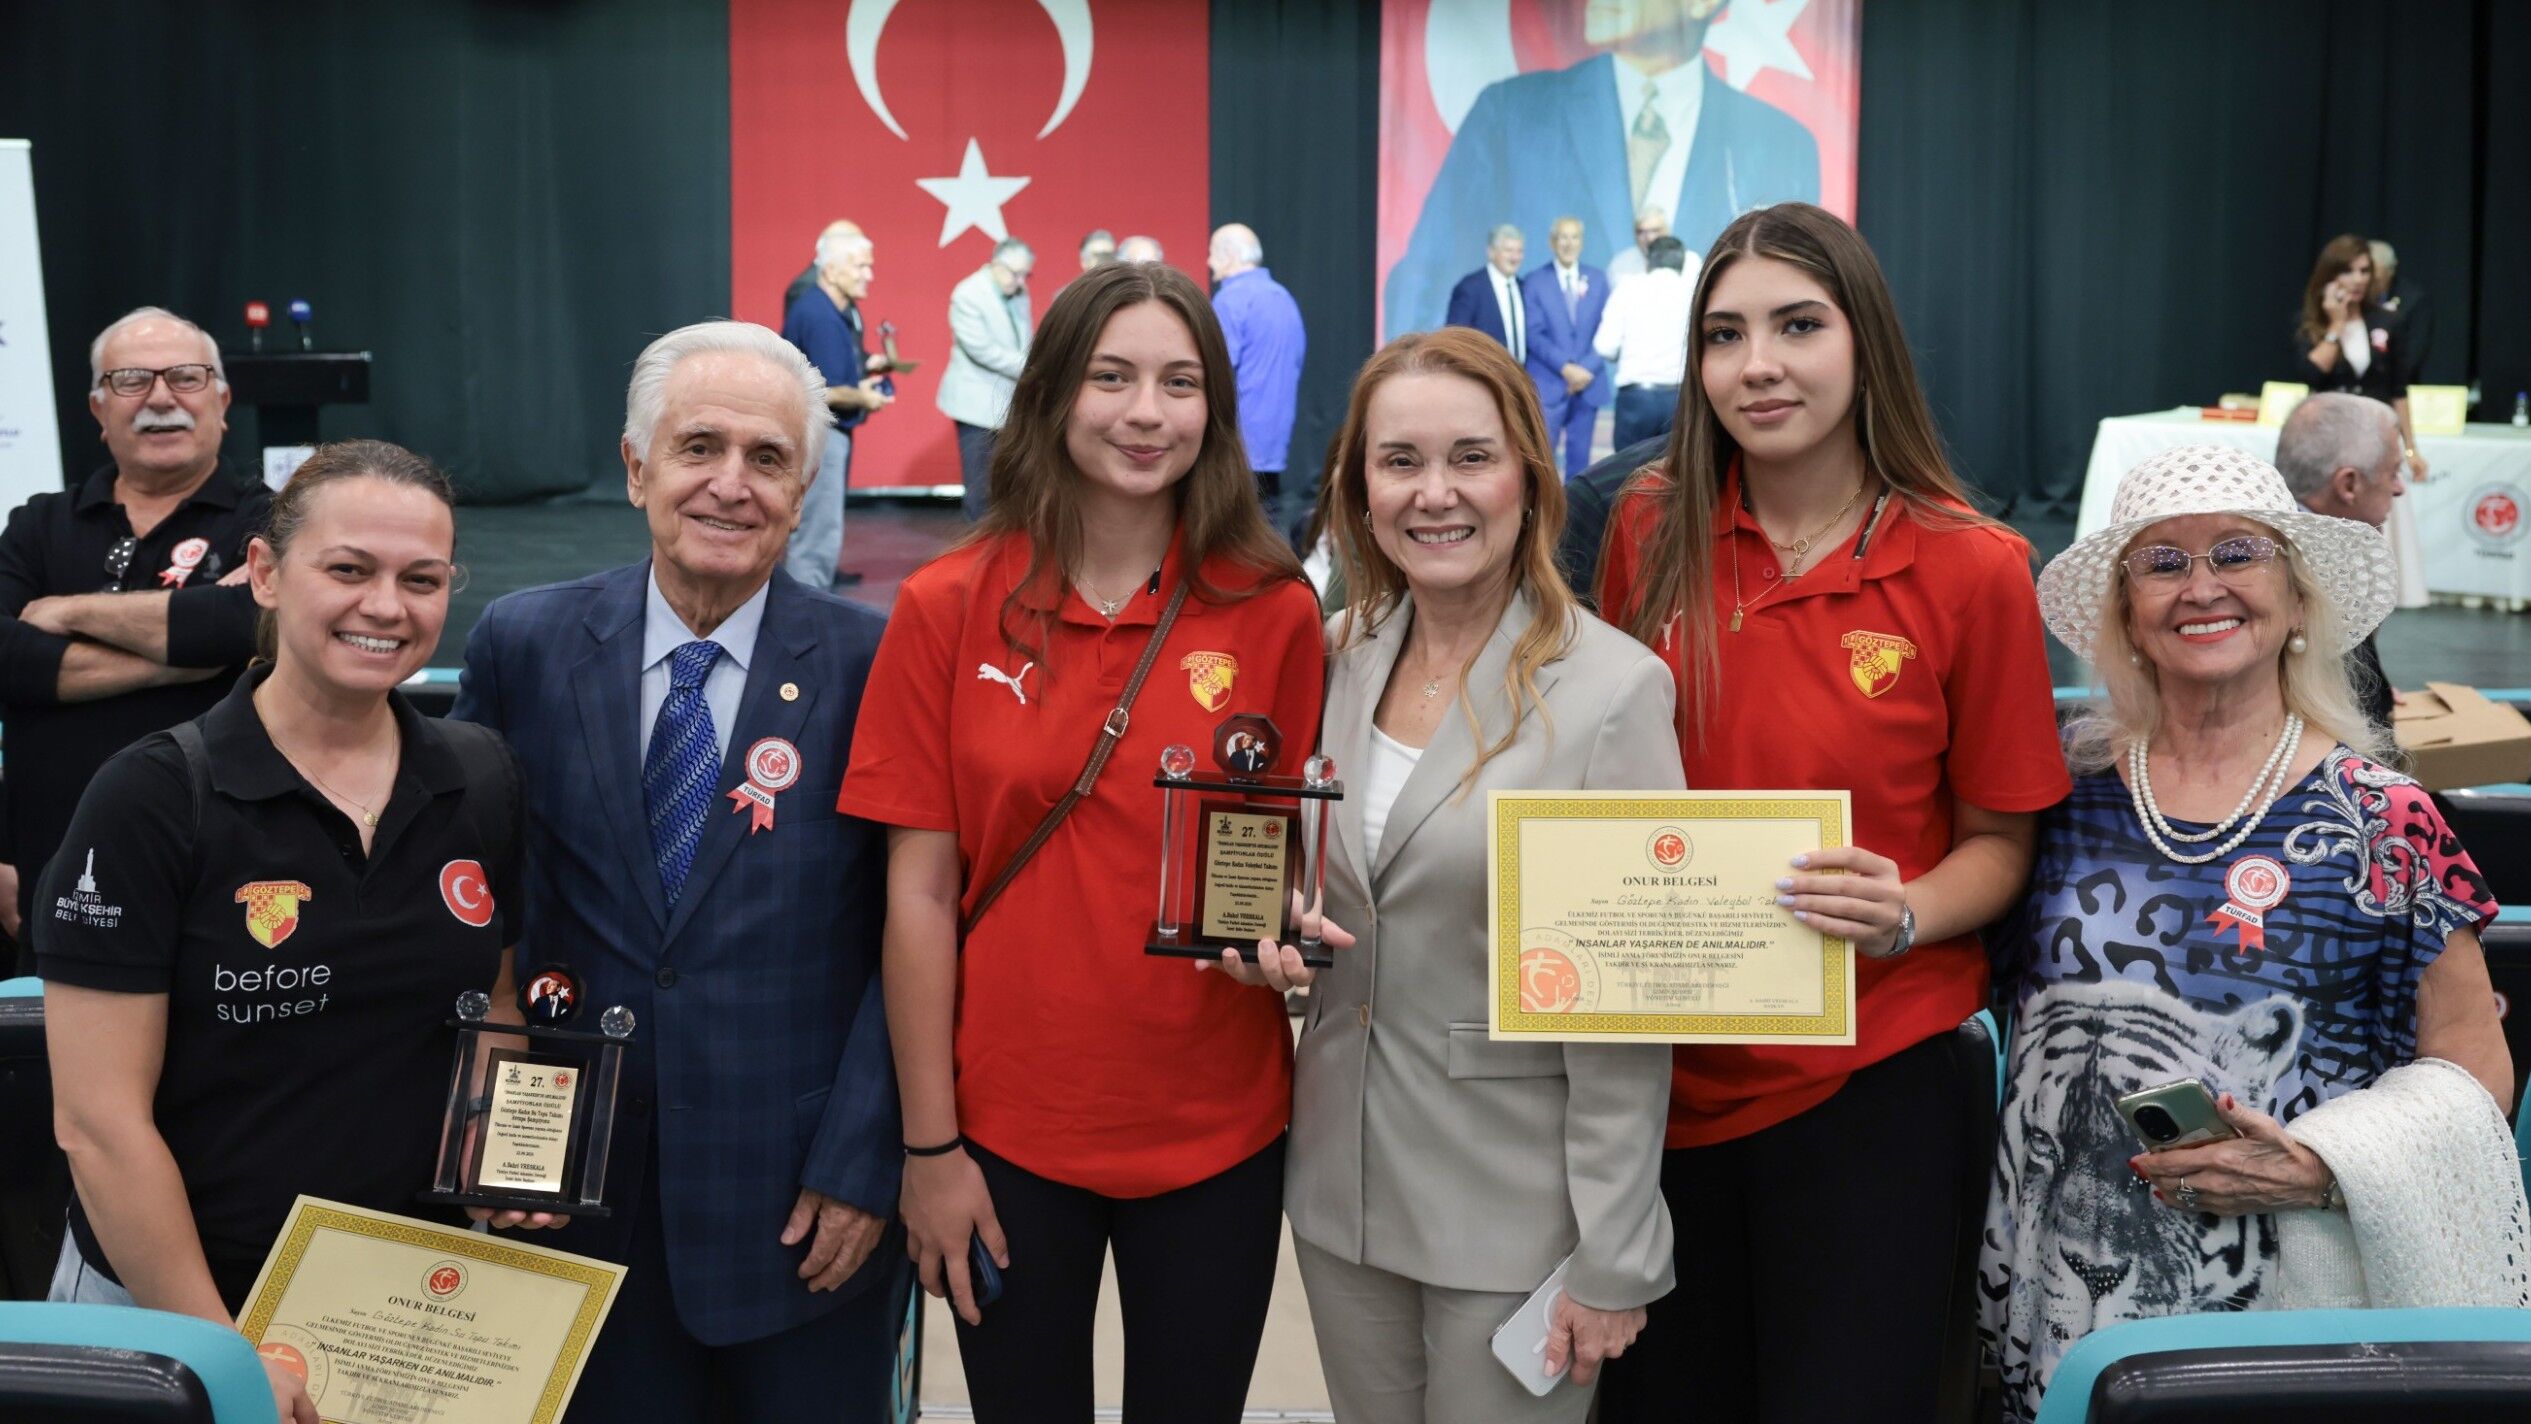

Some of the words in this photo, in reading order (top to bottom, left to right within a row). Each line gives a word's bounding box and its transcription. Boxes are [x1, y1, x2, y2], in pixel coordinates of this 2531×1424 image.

[743, 785, 771, 805] TÜRFAD
[1241, 826, 1257, 838] 27.
[1623, 877, 1659, 886] ONUR
[1663, 875, 1717, 886] BELGESİ
[56, 896, 122, 917] BÜYÜKŞEHİR
[2225, 905, 2259, 923] TÜRFAD
[1575, 938, 1628, 948] İNSANLAR
[1629, 939, 1684, 949] YAŞARKEN
[1686, 940, 1700, 949] DE
[214, 964, 331, 991] before
[216, 993, 330, 1023] sunset
[530, 1076, 545, 1088] 27.
[387, 1295, 423, 1312] ONUR
[424, 1303, 477, 1323] BELGESİ
[316, 1341, 367, 1360] İNSANLAR
[368, 1353, 420, 1371] YAŞARKEN
[420, 1365, 434, 1374] DE
